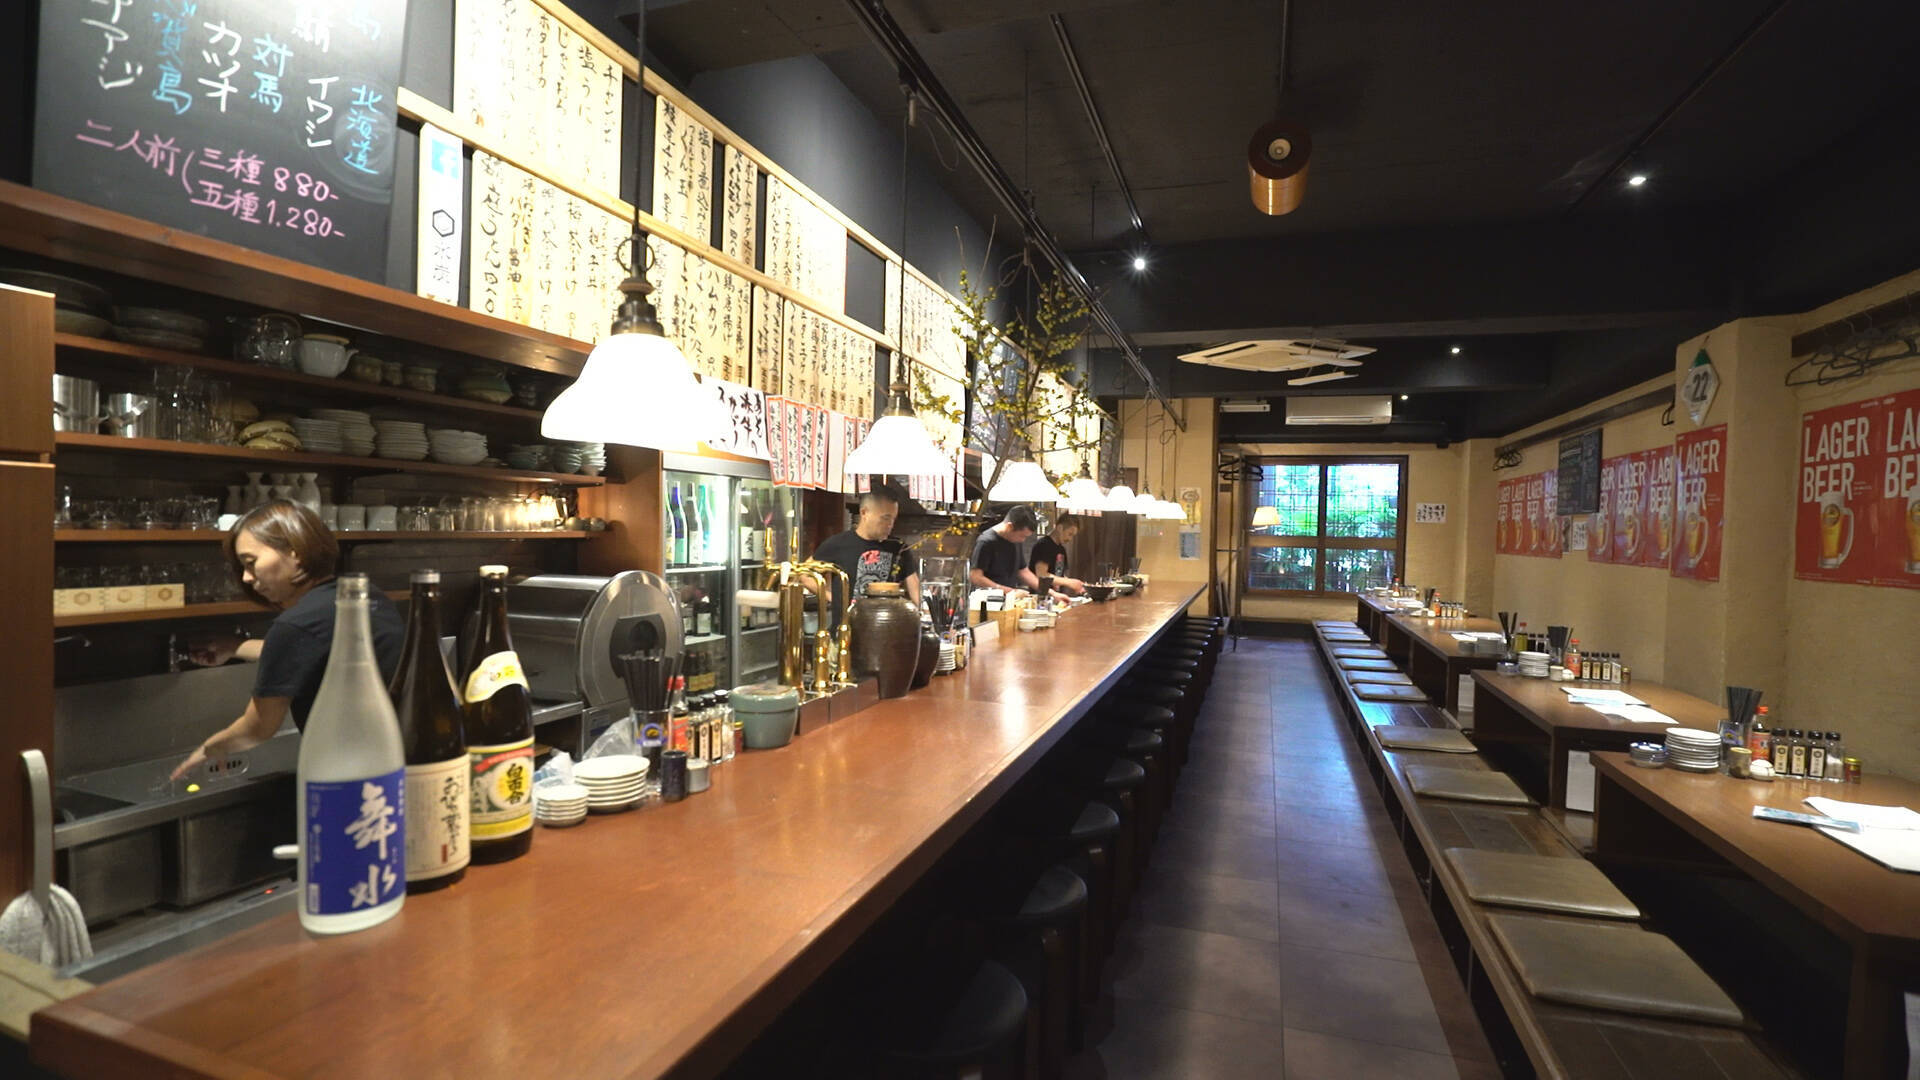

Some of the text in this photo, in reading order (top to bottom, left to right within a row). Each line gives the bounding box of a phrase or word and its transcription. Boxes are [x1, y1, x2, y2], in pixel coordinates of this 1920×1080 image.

[197, 21, 242, 113] カツオ
[252, 33, 294, 113] 対馬
[306, 76, 340, 148] イワシ
[344, 85, 384, 176] 北海道
[200, 148, 265, 185] 三種
[191, 180, 262, 225] 五種
[1692, 371, 1709, 402] 22
[1803, 416, 1870, 464] LAGER
[1886, 408, 1920, 453] LA
[1678, 439, 1720, 478] LAGER
[1884, 454, 1920, 499] BE
[1677, 477, 1708, 511] BEER
[1802, 462, 1855, 503] BEER
[507, 763, 524, 805] 白百合
